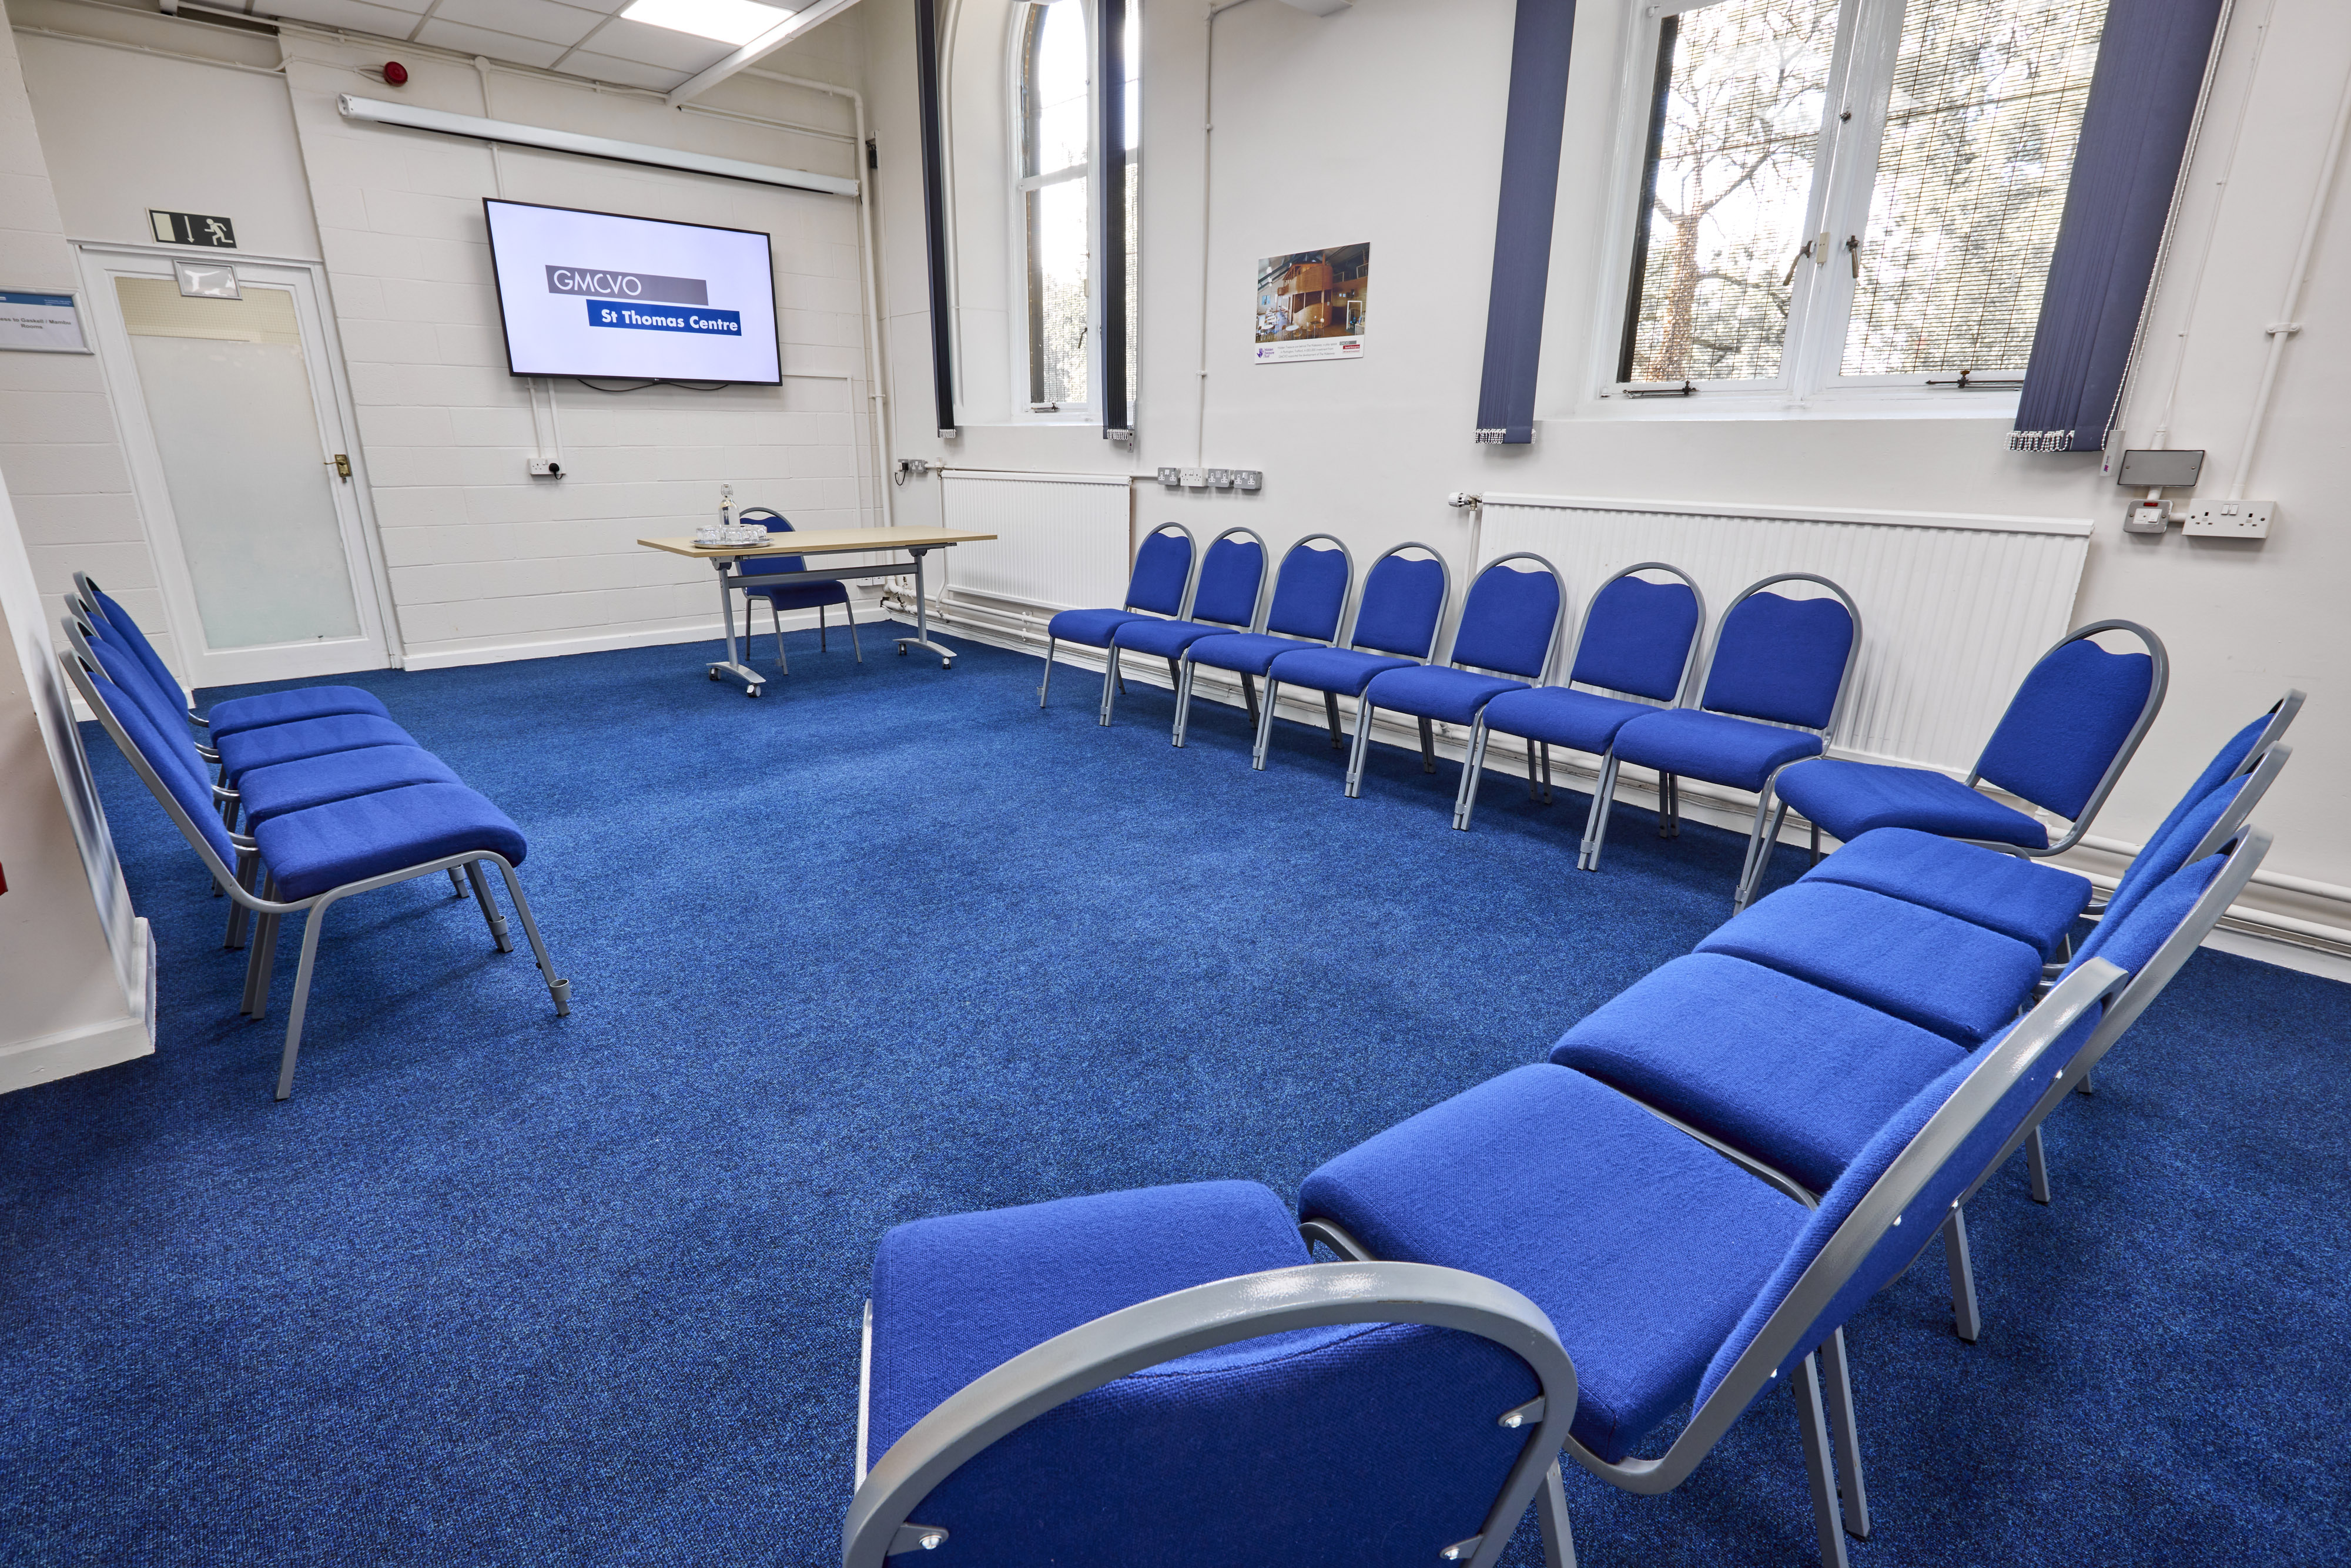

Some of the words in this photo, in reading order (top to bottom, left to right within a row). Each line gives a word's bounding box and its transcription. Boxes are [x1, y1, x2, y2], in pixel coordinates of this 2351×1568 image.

[554, 269, 642, 296] GMCVO
[601, 309, 618, 324] St
[622, 310, 685, 328] Thomas
[689, 316, 738, 331] Centre
